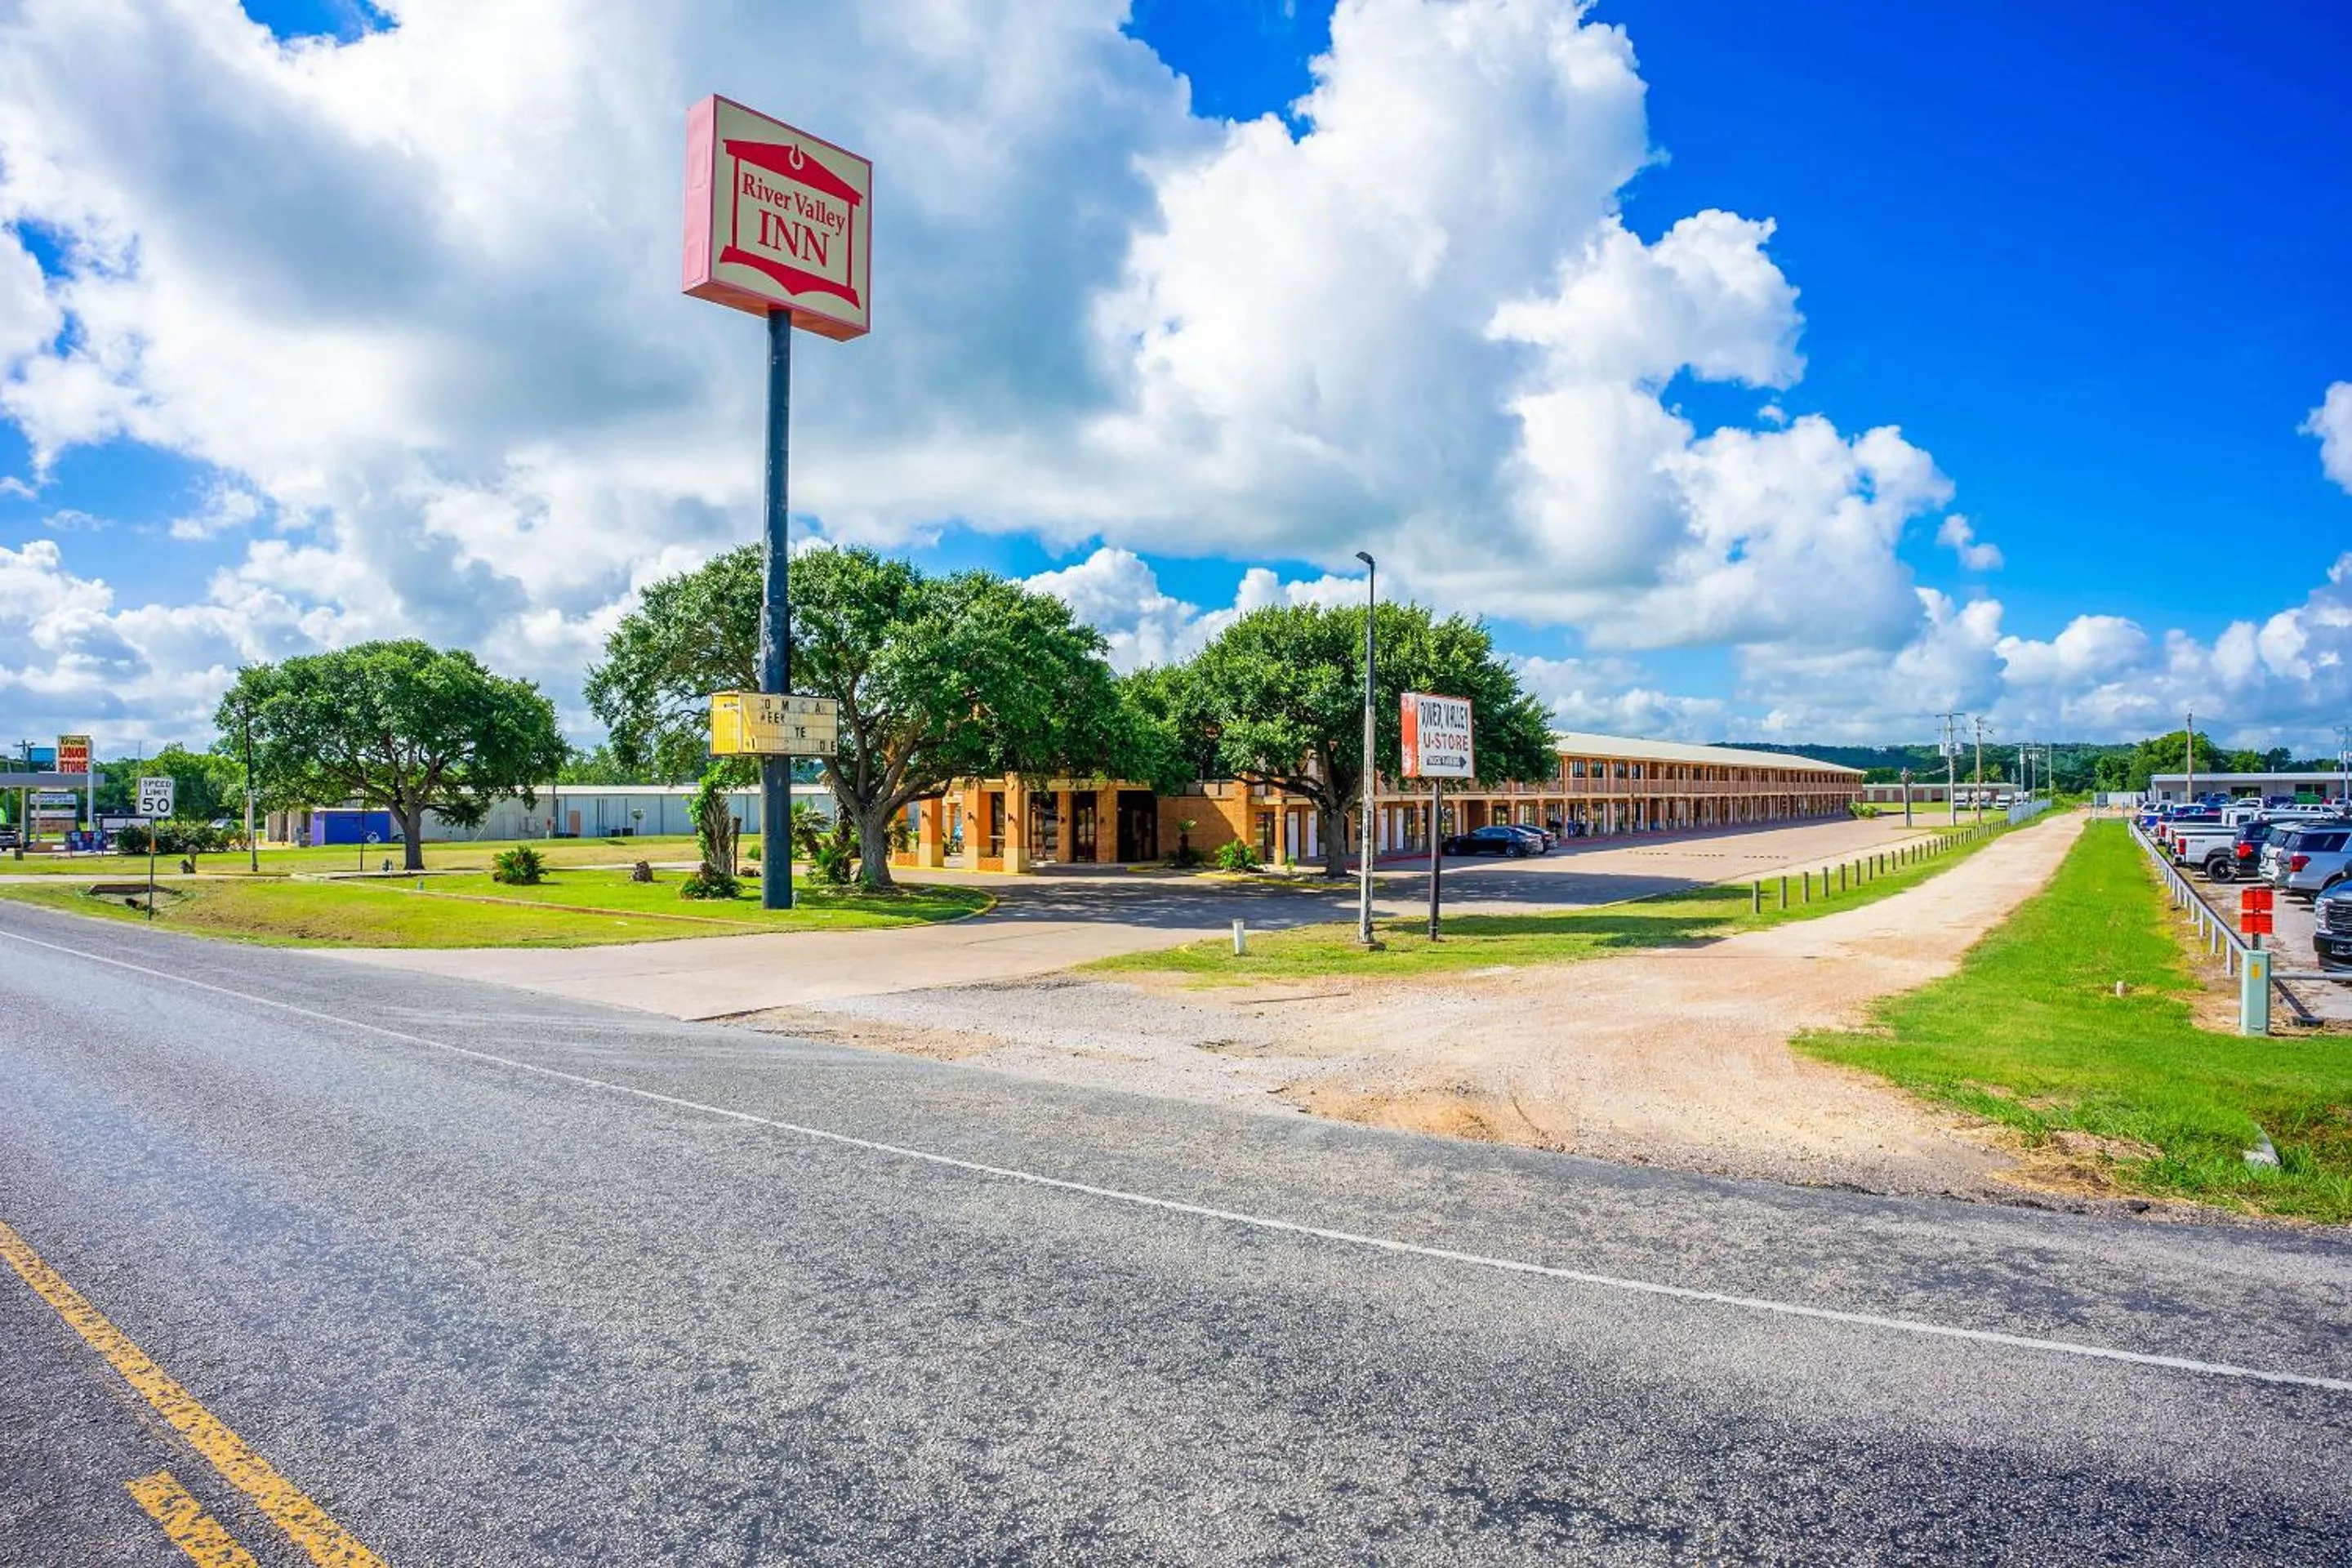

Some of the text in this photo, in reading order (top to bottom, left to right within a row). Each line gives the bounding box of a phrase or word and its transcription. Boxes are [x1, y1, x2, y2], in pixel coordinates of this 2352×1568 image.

[742, 172, 846, 235] River Valley
[757, 208, 830, 268] INN
[1423, 732, 1468, 751] U-STORE
[59, 746, 87, 758] LIQUOR
[59, 760, 87, 773] STORE
[143, 779, 172, 788] SPEED
[145, 788, 168, 796] LIMIT
[142, 797, 170, 813] 50
